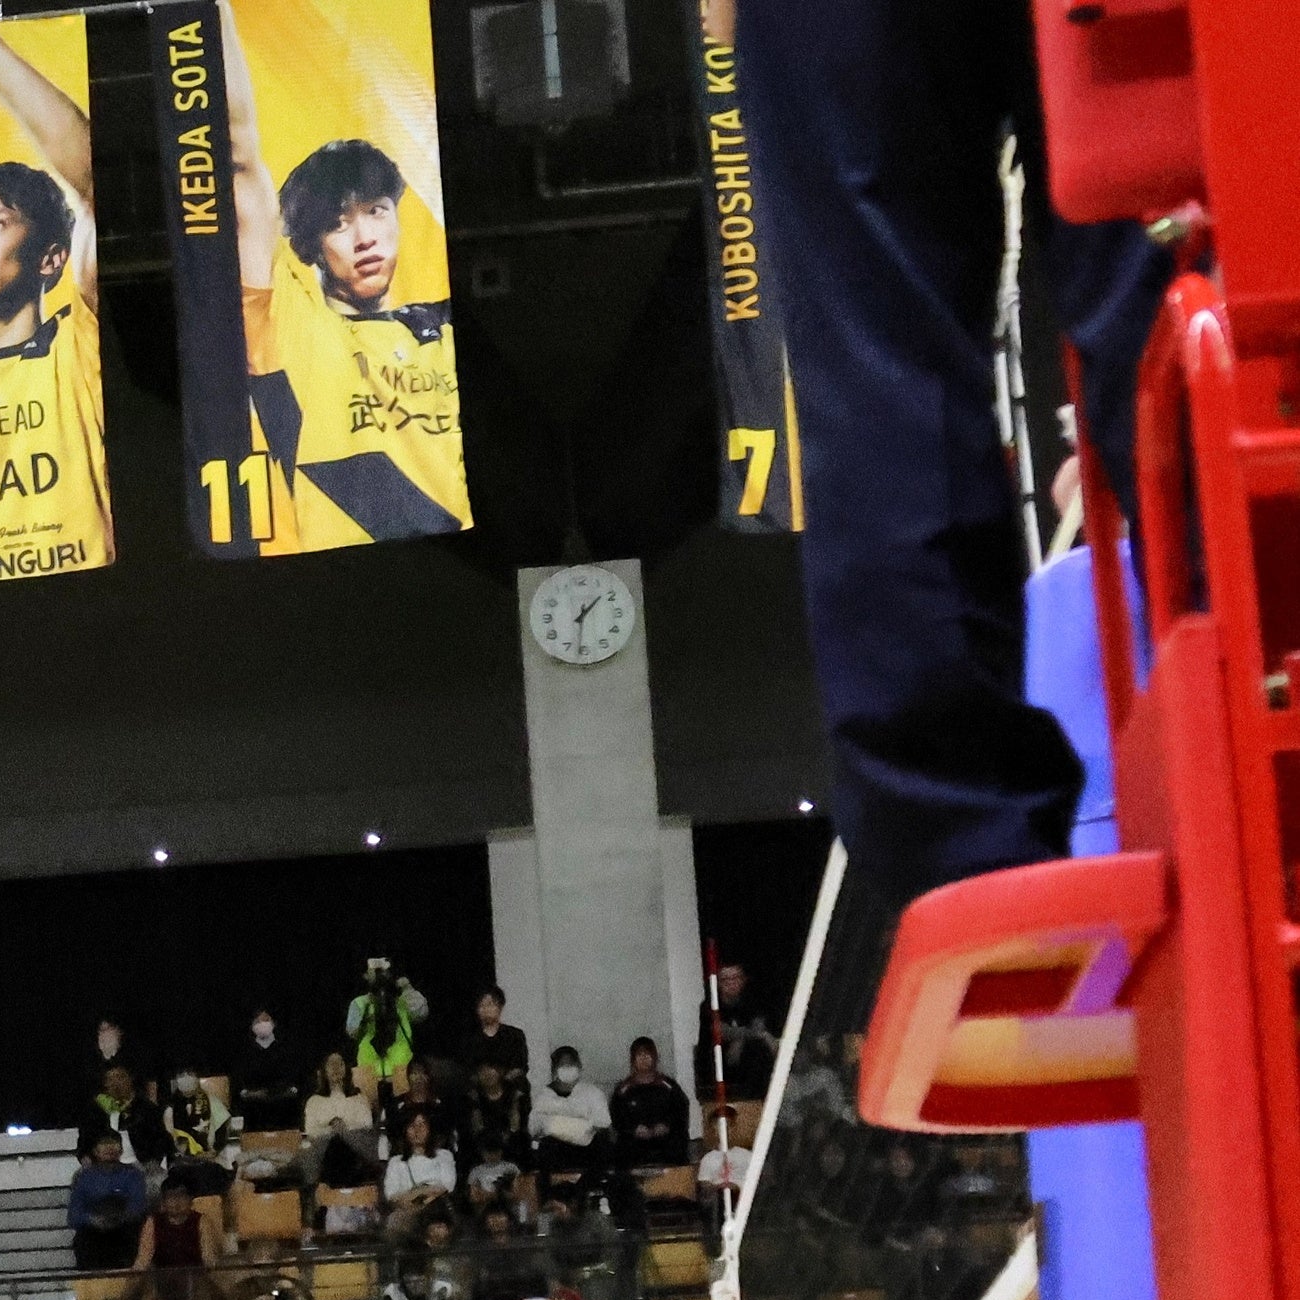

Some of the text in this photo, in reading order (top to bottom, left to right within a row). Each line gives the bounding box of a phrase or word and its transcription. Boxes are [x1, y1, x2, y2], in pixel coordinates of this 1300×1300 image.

[168, 20, 220, 236] IKEDA SOTA
[711, 108, 760, 322] KUBOSHITA
[200, 452, 275, 544] 11
[728, 428, 776, 517] 7
